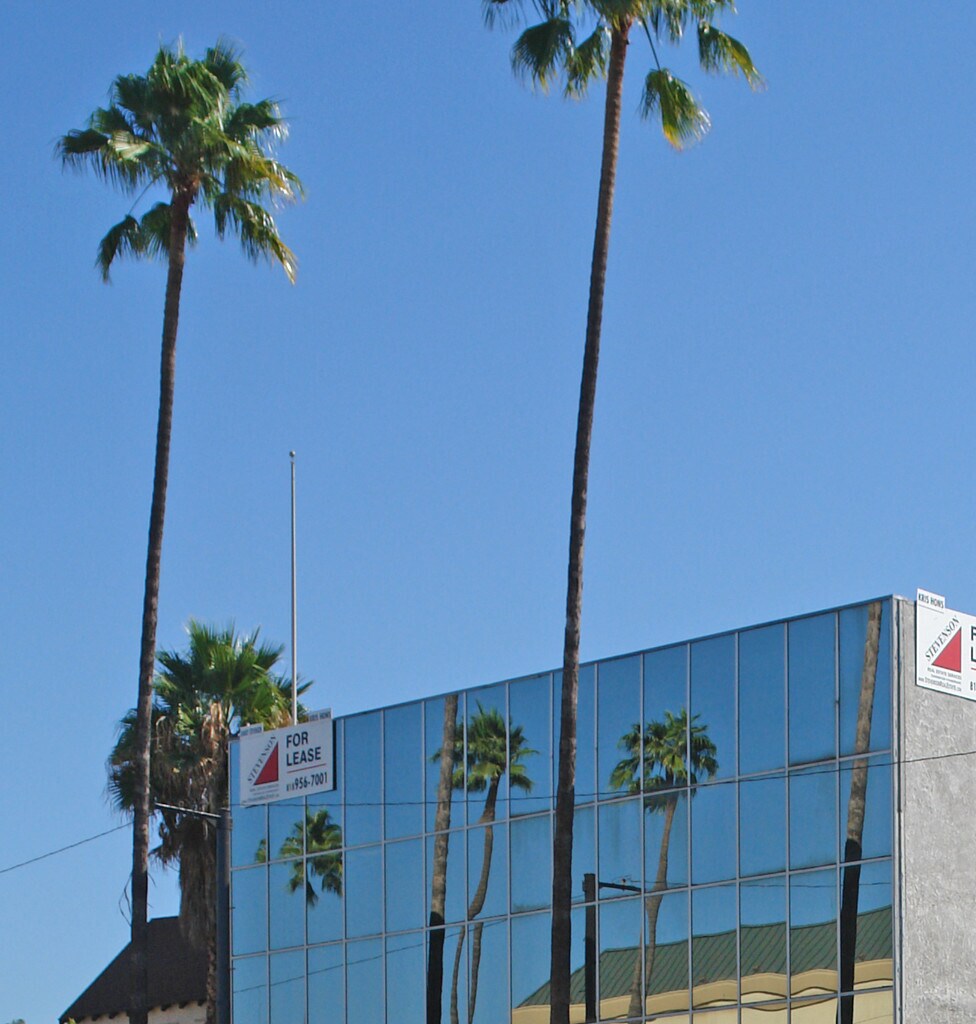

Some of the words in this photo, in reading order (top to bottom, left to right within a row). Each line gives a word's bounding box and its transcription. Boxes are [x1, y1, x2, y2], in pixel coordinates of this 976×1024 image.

[925, 615, 960, 662] STEVENSON
[286, 731, 309, 749] FOR
[286, 746, 322, 767] LEASE
